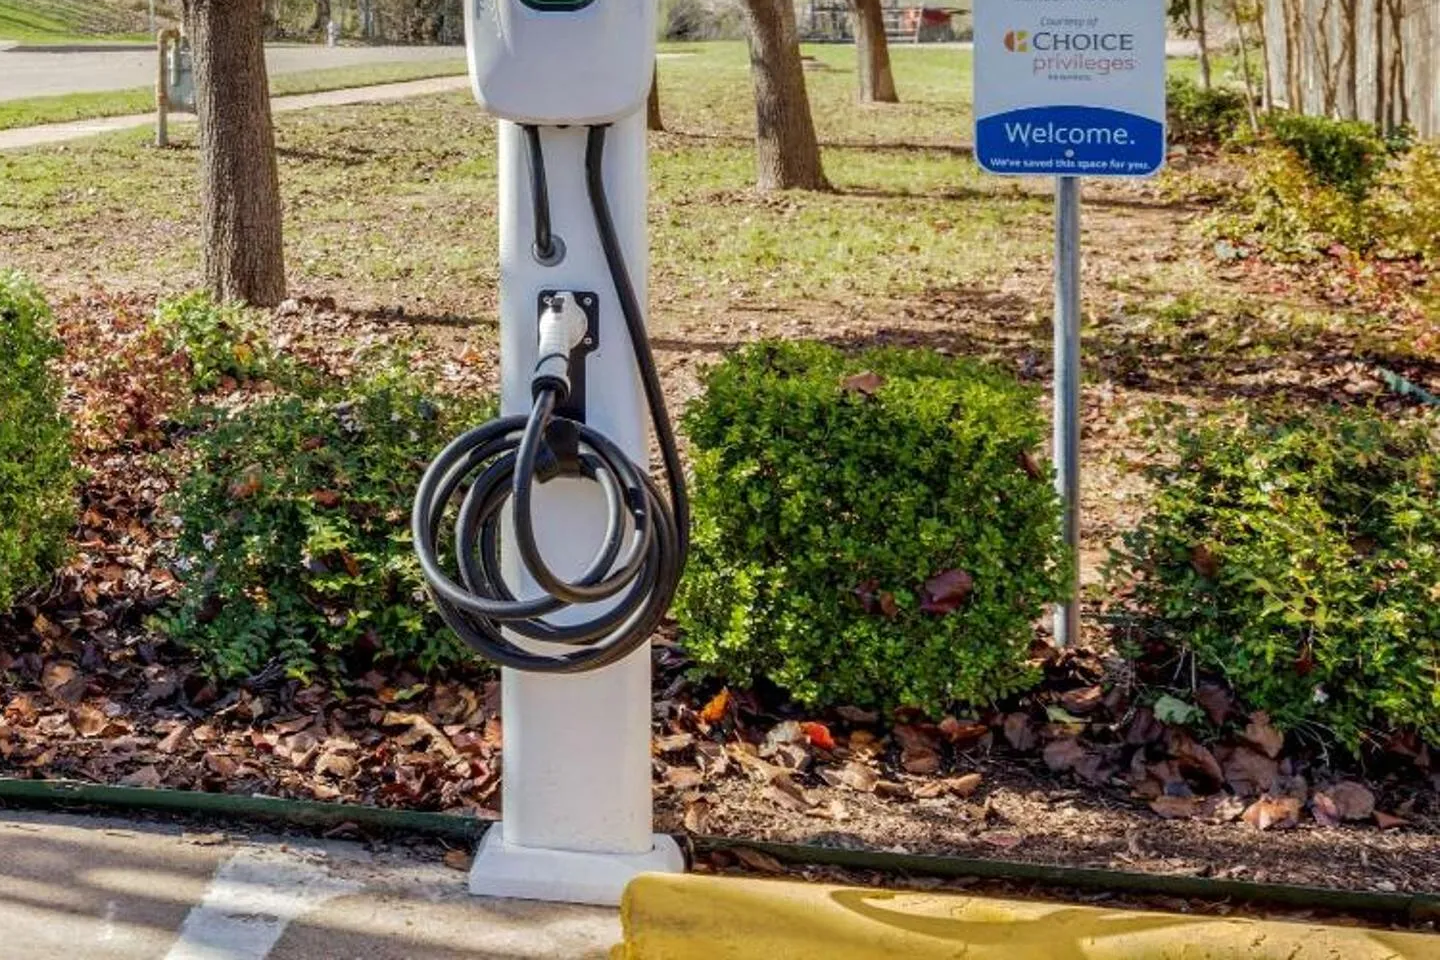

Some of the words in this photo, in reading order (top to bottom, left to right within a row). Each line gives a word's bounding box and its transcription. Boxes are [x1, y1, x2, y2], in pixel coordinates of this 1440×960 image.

[1032, 31, 1135, 52] CHOICE
[1033, 54, 1136, 76] privileges
[1004, 121, 1136, 146] Welcome.
[990, 157, 1021, 168] We've
[1023, 158, 1053, 168] saved
[1055, 158, 1076, 168] this
[1078, 160, 1108, 170] space
[1109, 158, 1126, 169] for
